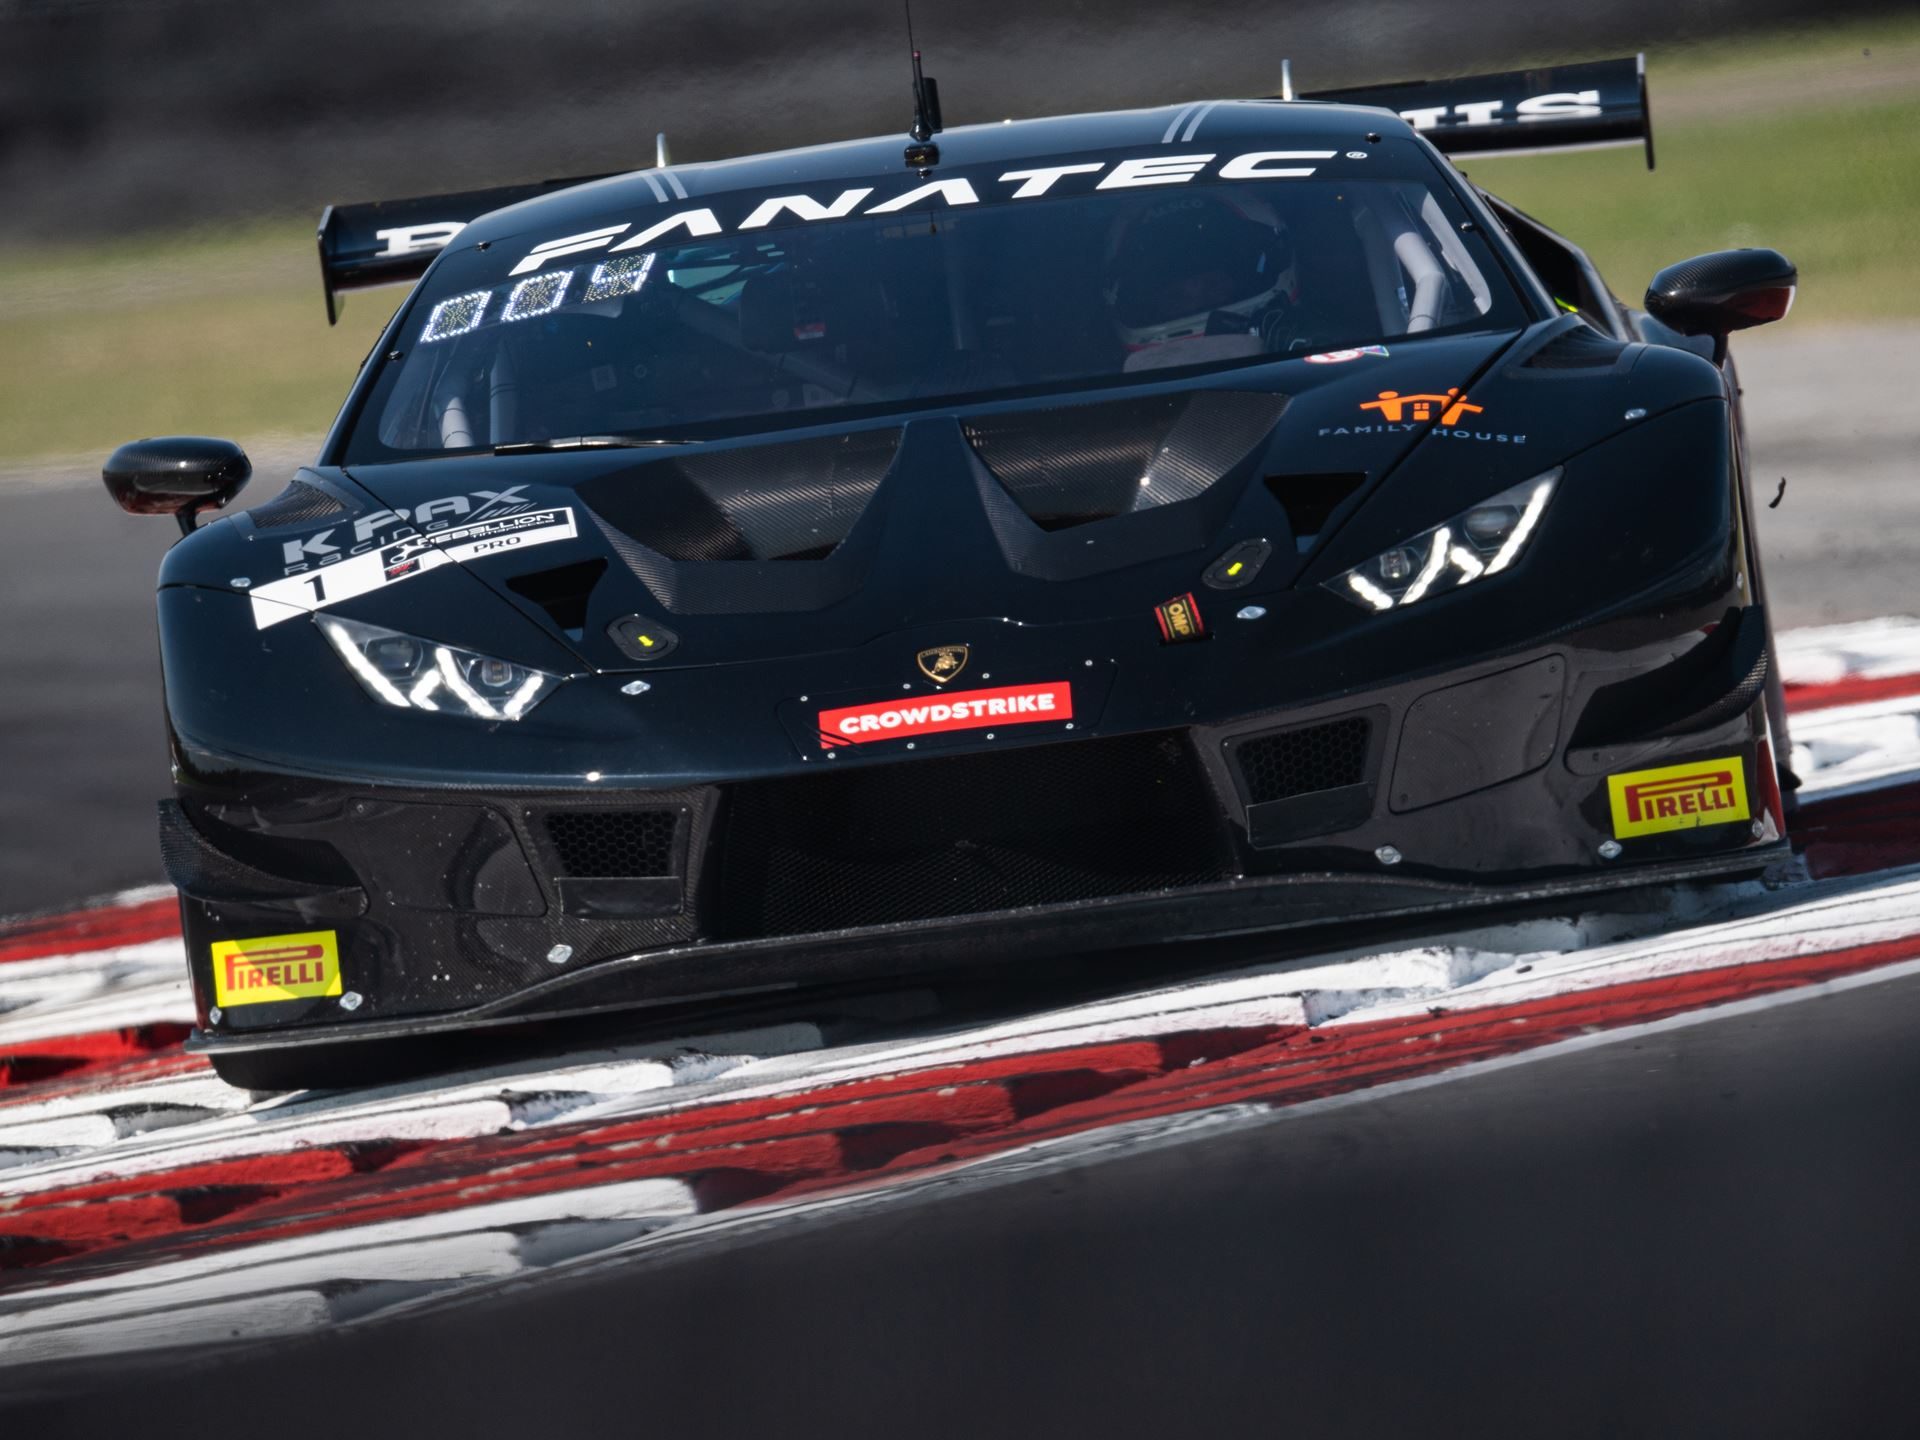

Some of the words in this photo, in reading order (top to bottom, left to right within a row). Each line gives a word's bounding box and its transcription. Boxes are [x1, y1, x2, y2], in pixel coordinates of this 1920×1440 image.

[1318, 423, 1417, 437] FAMILY
[1431, 428, 1528, 444] HOUSE
[473, 536, 521, 553] PRO
[303, 575, 326, 602] 1
[1168, 602, 1190, 636] OMP
[839, 693, 1056, 735] CROWDSTRIKE
[1624, 770, 1736, 823] PIRELLI
[224, 943, 325, 991] PIRELLI
